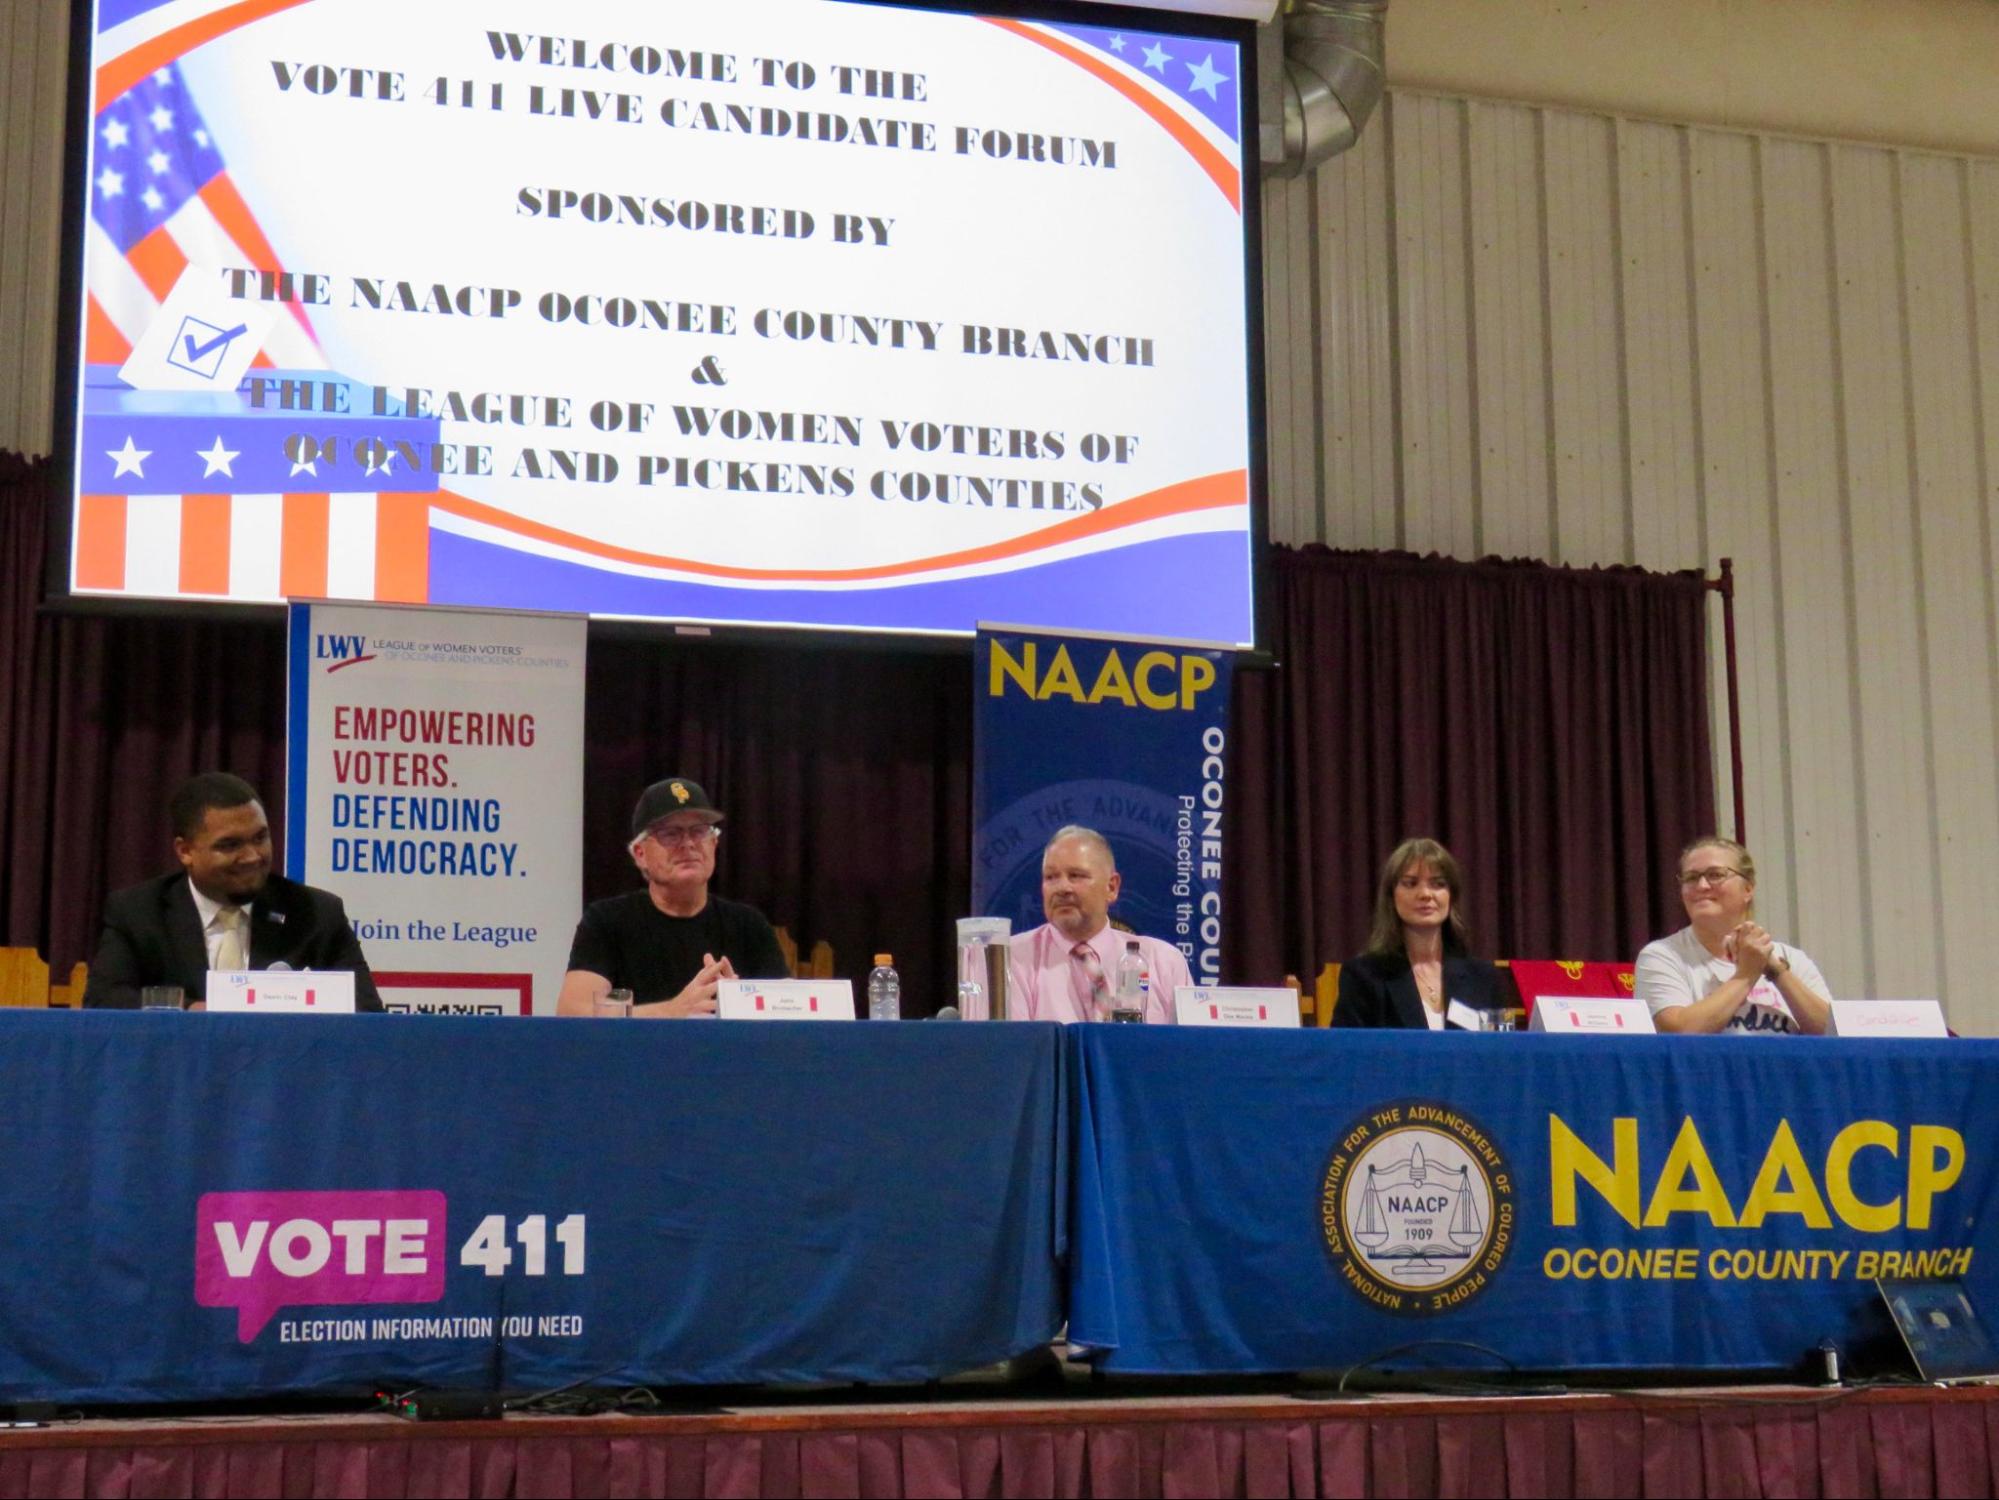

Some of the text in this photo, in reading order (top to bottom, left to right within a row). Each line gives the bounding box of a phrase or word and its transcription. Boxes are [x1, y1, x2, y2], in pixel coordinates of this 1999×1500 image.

[487, 31, 927, 101] WELCOME TO THE
[270, 61, 1118, 168] VOTE 411 LIVE CANDIDATE FORUM
[517, 187, 895, 246] SPONSORED BY
[222, 268, 1155, 366] THE NAACP OCONEE COUNTY BRANCH
[691, 355, 728, 386] &
[243, 378, 1139, 464] THE LEAGUE OF WOMEN VOTERS OF
[284, 433, 1104, 512] OCONEE AND PICKENS COUNTIES
[317, 634, 366, 659] LWV
[373, 639, 521, 656] LEAGUE OF WOMEN VOTERS
[990, 638, 1216, 711] NAACP
[334, 706, 535, 747] EMPOWERING
[333, 750, 458, 788] VOTERS.
[332, 793, 501, 833] DEFENDING
[1032, 799, 1075, 829] THE
[1202, 727, 1225, 880] OCONEE
[331, 837, 527, 877] DEMOCRACY.
[1172, 795, 1195, 898] Protecting
[352, 920, 537, 948] Join the League
[1176, 903, 1194, 935] the
[1549, 1113, 1967, 1233] NAACP
[1322, 1106, 1513, 1309] NATIONAL ASSOCIATION FOR THE ADVANCEMENT OF COLORED PEOPLE
[1388, 1196, 1449, 1213] NAACP
[213, 1214, 586, 1278] VOTE 411
[1404, 1228, 1434, 1241] 1909
[1543, 1246, 1974, 1280] OCONEE COUNTY BRANCH
[280, 1315, 583, 1342] ELECTION INFORMATION YOU NEED
